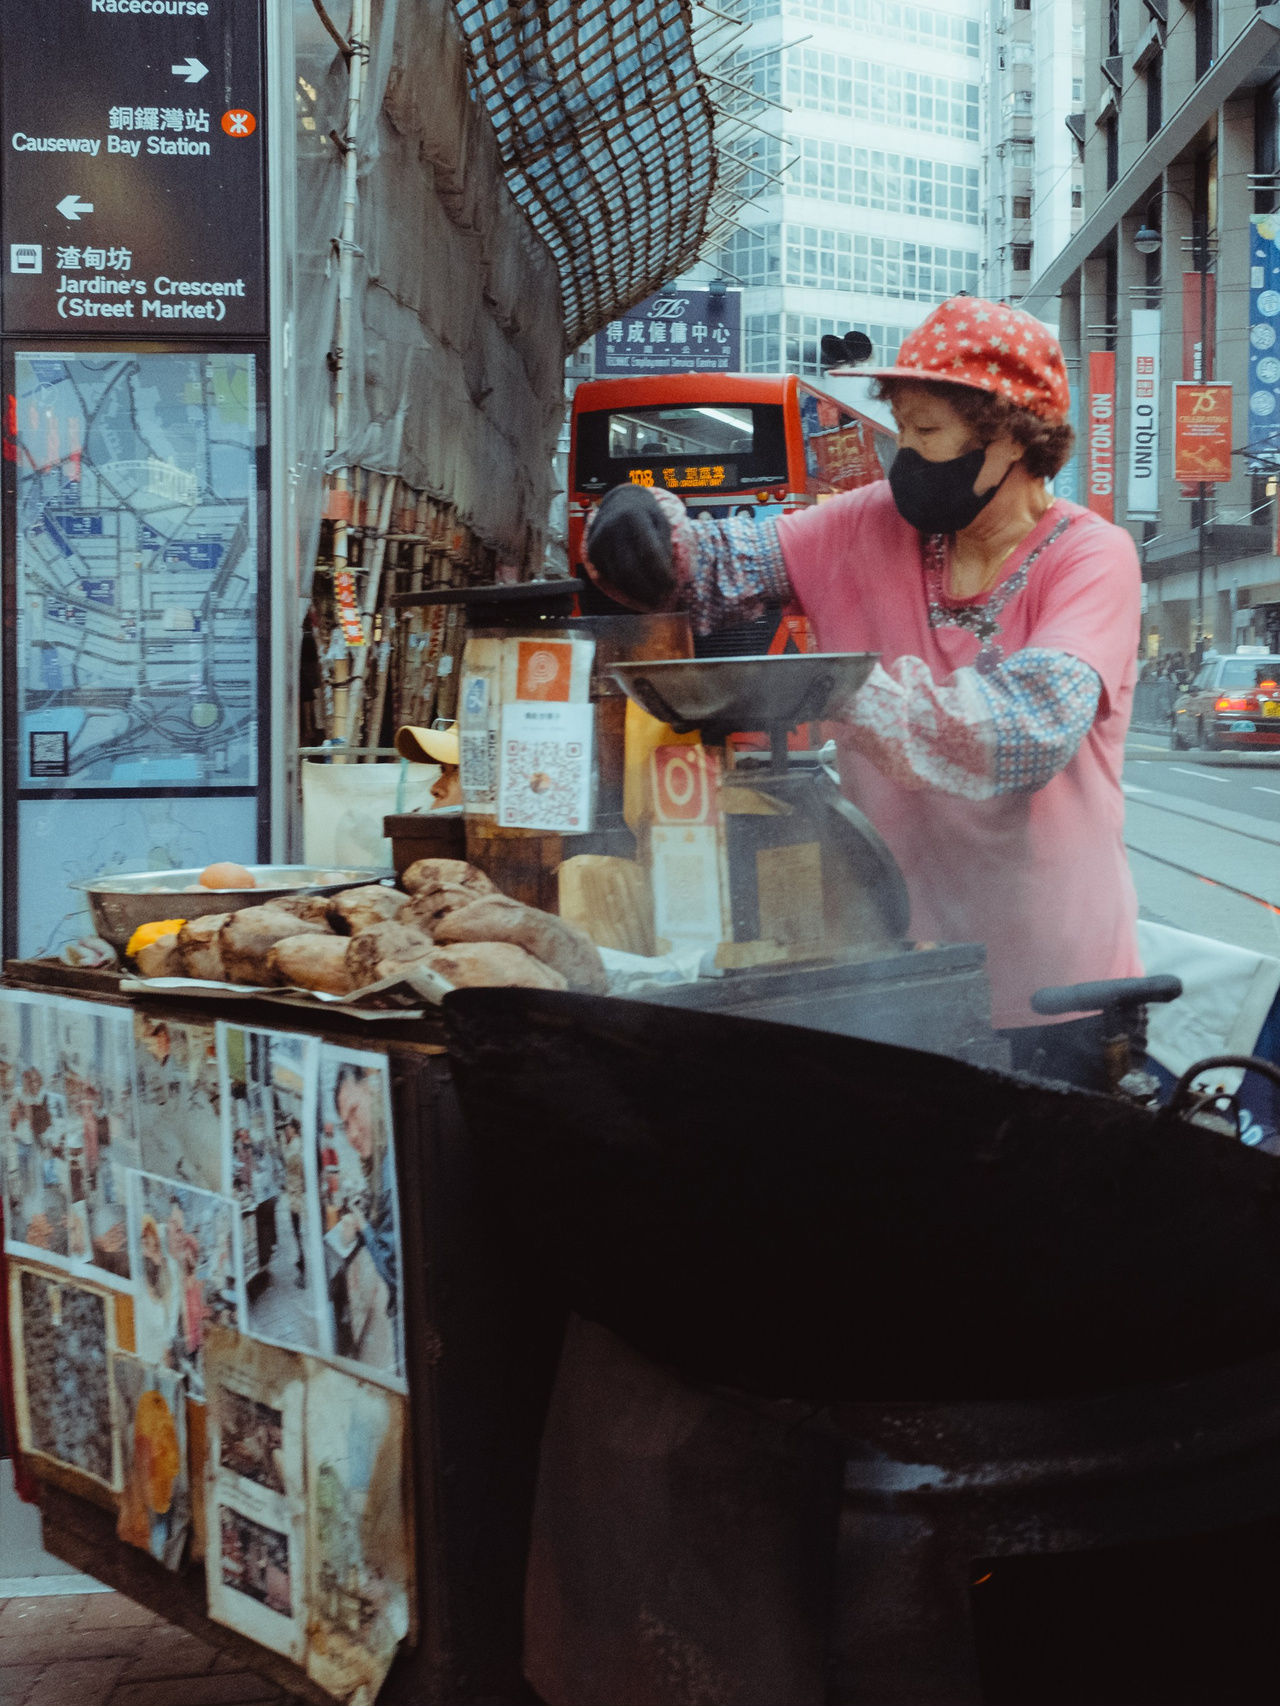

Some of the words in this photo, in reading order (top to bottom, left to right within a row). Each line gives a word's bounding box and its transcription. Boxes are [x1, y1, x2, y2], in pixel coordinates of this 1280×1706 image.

[91, 0, 209, 15] Racecourse
[108, 106, 210, 132] 銅鑼灣站
[12, 132, 100, 156] Causeway
[107, 136, 141, 157] Bay
[147, 136, 210, 155] Station
[56, 246, 132, 271] 渣甸坊
[56, 275, 147, 295] Jardine's
[154, 276, 245, 297] Crescent
[57, 297, 134, 319] (Street
[142, 299, 226, 321] Market)
[606, 320, 731, 343] 得成僱傭中心
[1091, 393, 1112, 419] ON
[1135, 404, 1158, 479] UNIQLO
[1091, 424, 1112, 495] COTTON
[629, 469, 655, 488] 108
